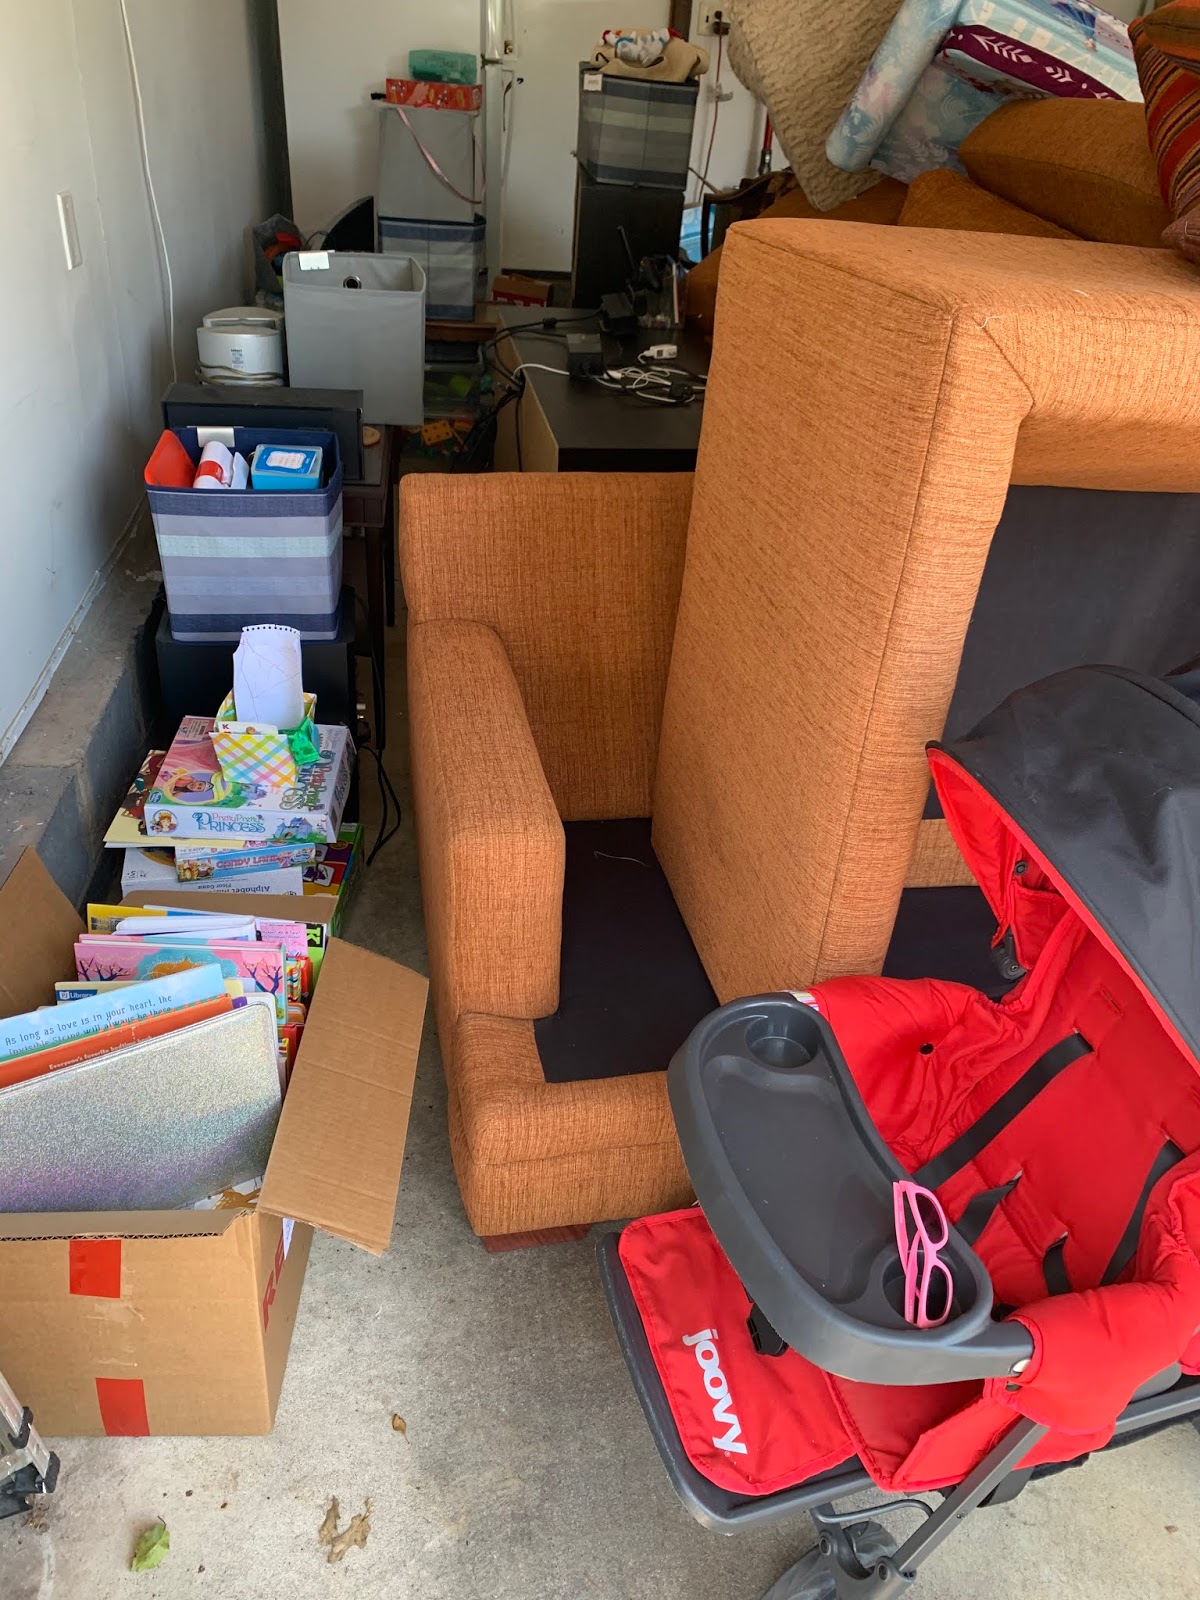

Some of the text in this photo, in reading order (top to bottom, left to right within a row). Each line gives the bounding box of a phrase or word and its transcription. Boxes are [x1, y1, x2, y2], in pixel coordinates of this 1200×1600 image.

[192, 812, 265, 833] PRINCESS
[216, 857, 250, 869] CANDY
[5, 995, 173, 1046] As long as love is in your heart, the
[682, 1328, 748, 1455] joovy
